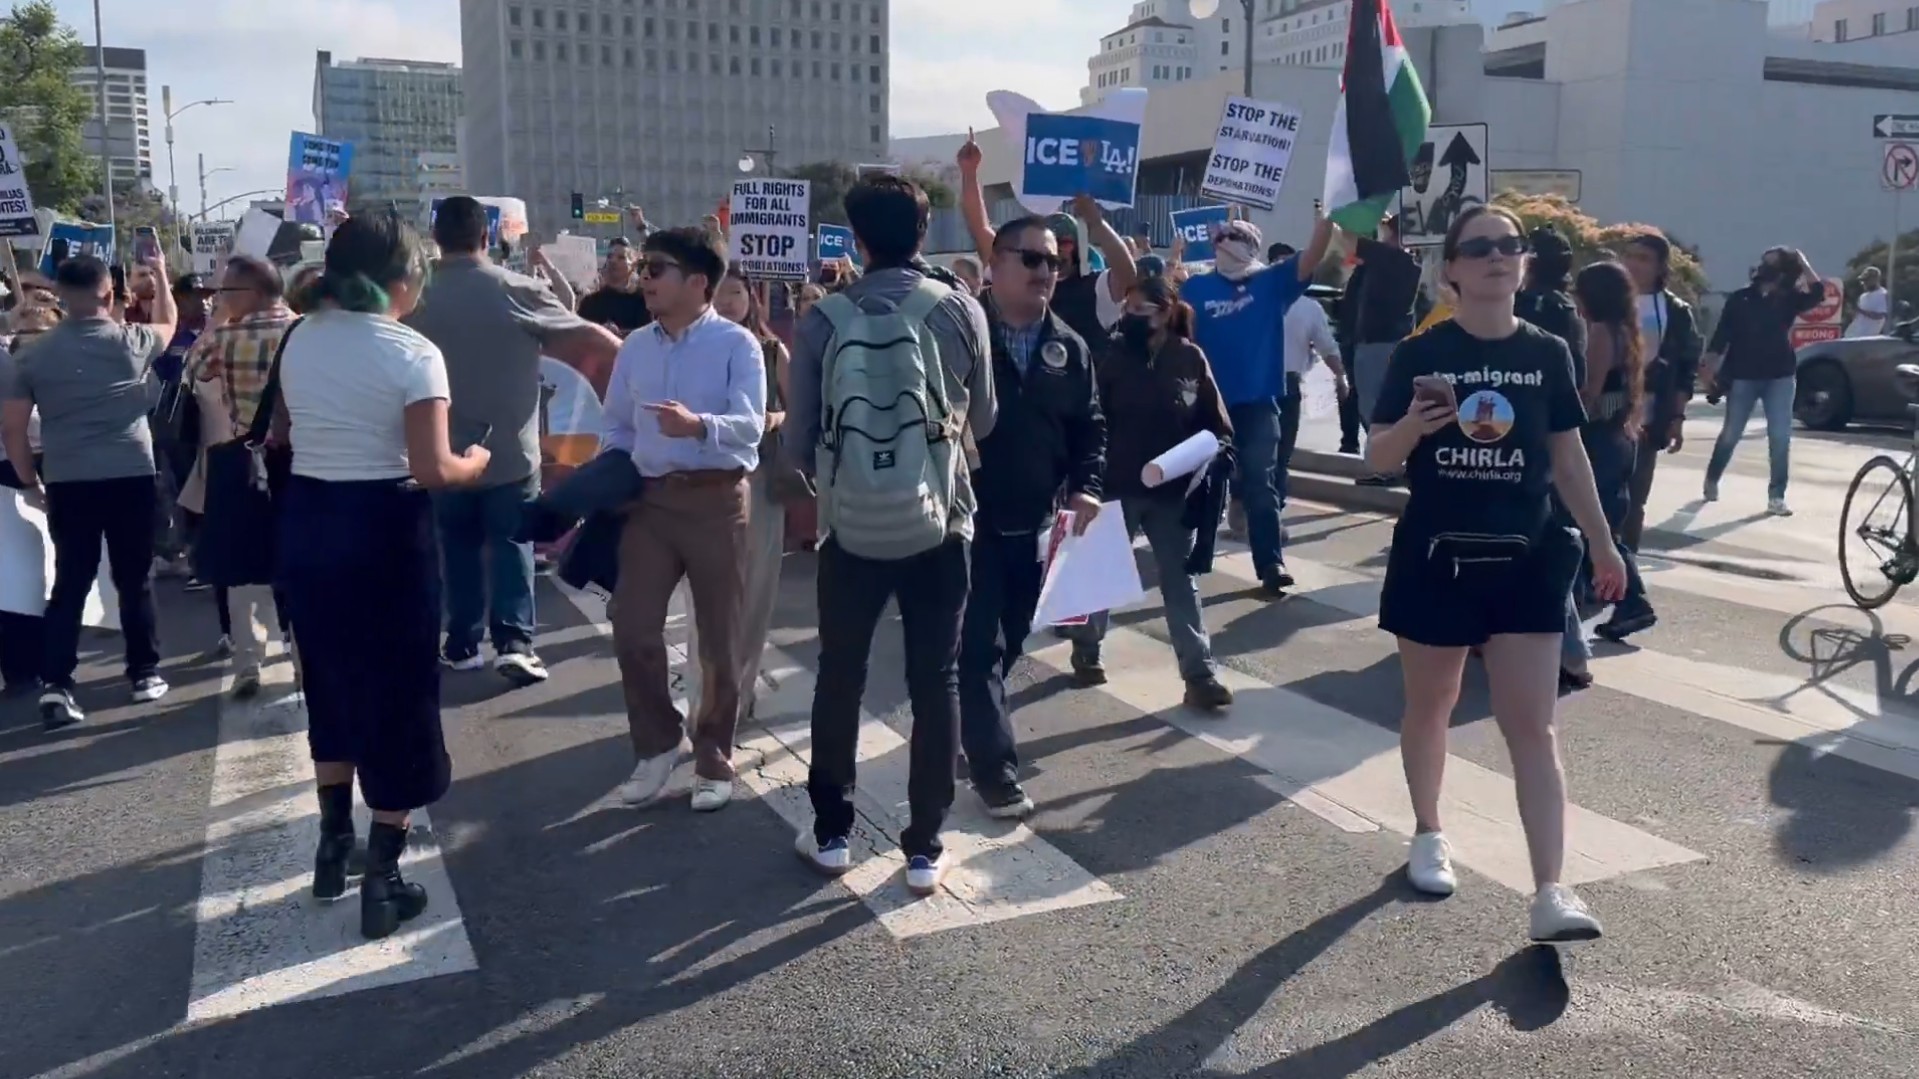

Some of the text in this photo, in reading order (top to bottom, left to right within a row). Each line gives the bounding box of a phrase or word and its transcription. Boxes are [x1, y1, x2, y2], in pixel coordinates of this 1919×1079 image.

[1226, 102, 1299, 131] STOP THE
[1220, 125, 1291, 151] STARVATION!
[1026, 136, 1135, 174] ICE LA!
[1211, 153, 1283, 182] STOP THE
[733, 182, 805, 197] FULL RIGHTS
[745, 196, 791, 211] FOR ALL
[731, 212, 806, 227] IMMIGRANTS
[740, 233, 795, 257] STOP
[820, 233, 843, 247] ICE
[1435, 447, 1525, 468] CHIRLA
